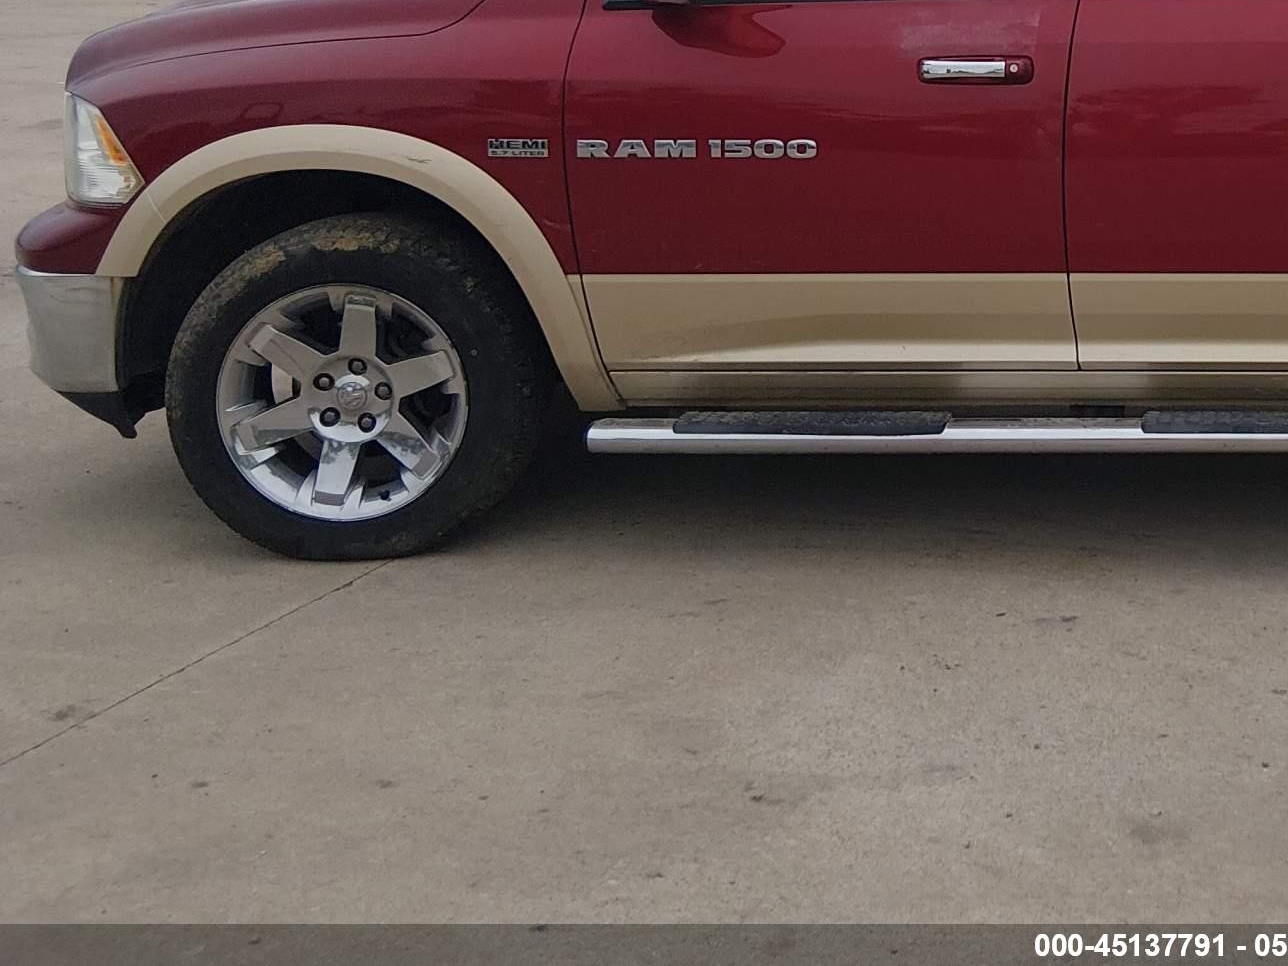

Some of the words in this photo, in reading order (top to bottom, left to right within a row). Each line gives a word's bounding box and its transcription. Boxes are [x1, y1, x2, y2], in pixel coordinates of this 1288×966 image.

[489, 139, 546, 150] HEMI
[576, 139, 697, 158] RAM
[708, 139, 817, 159] 1500
